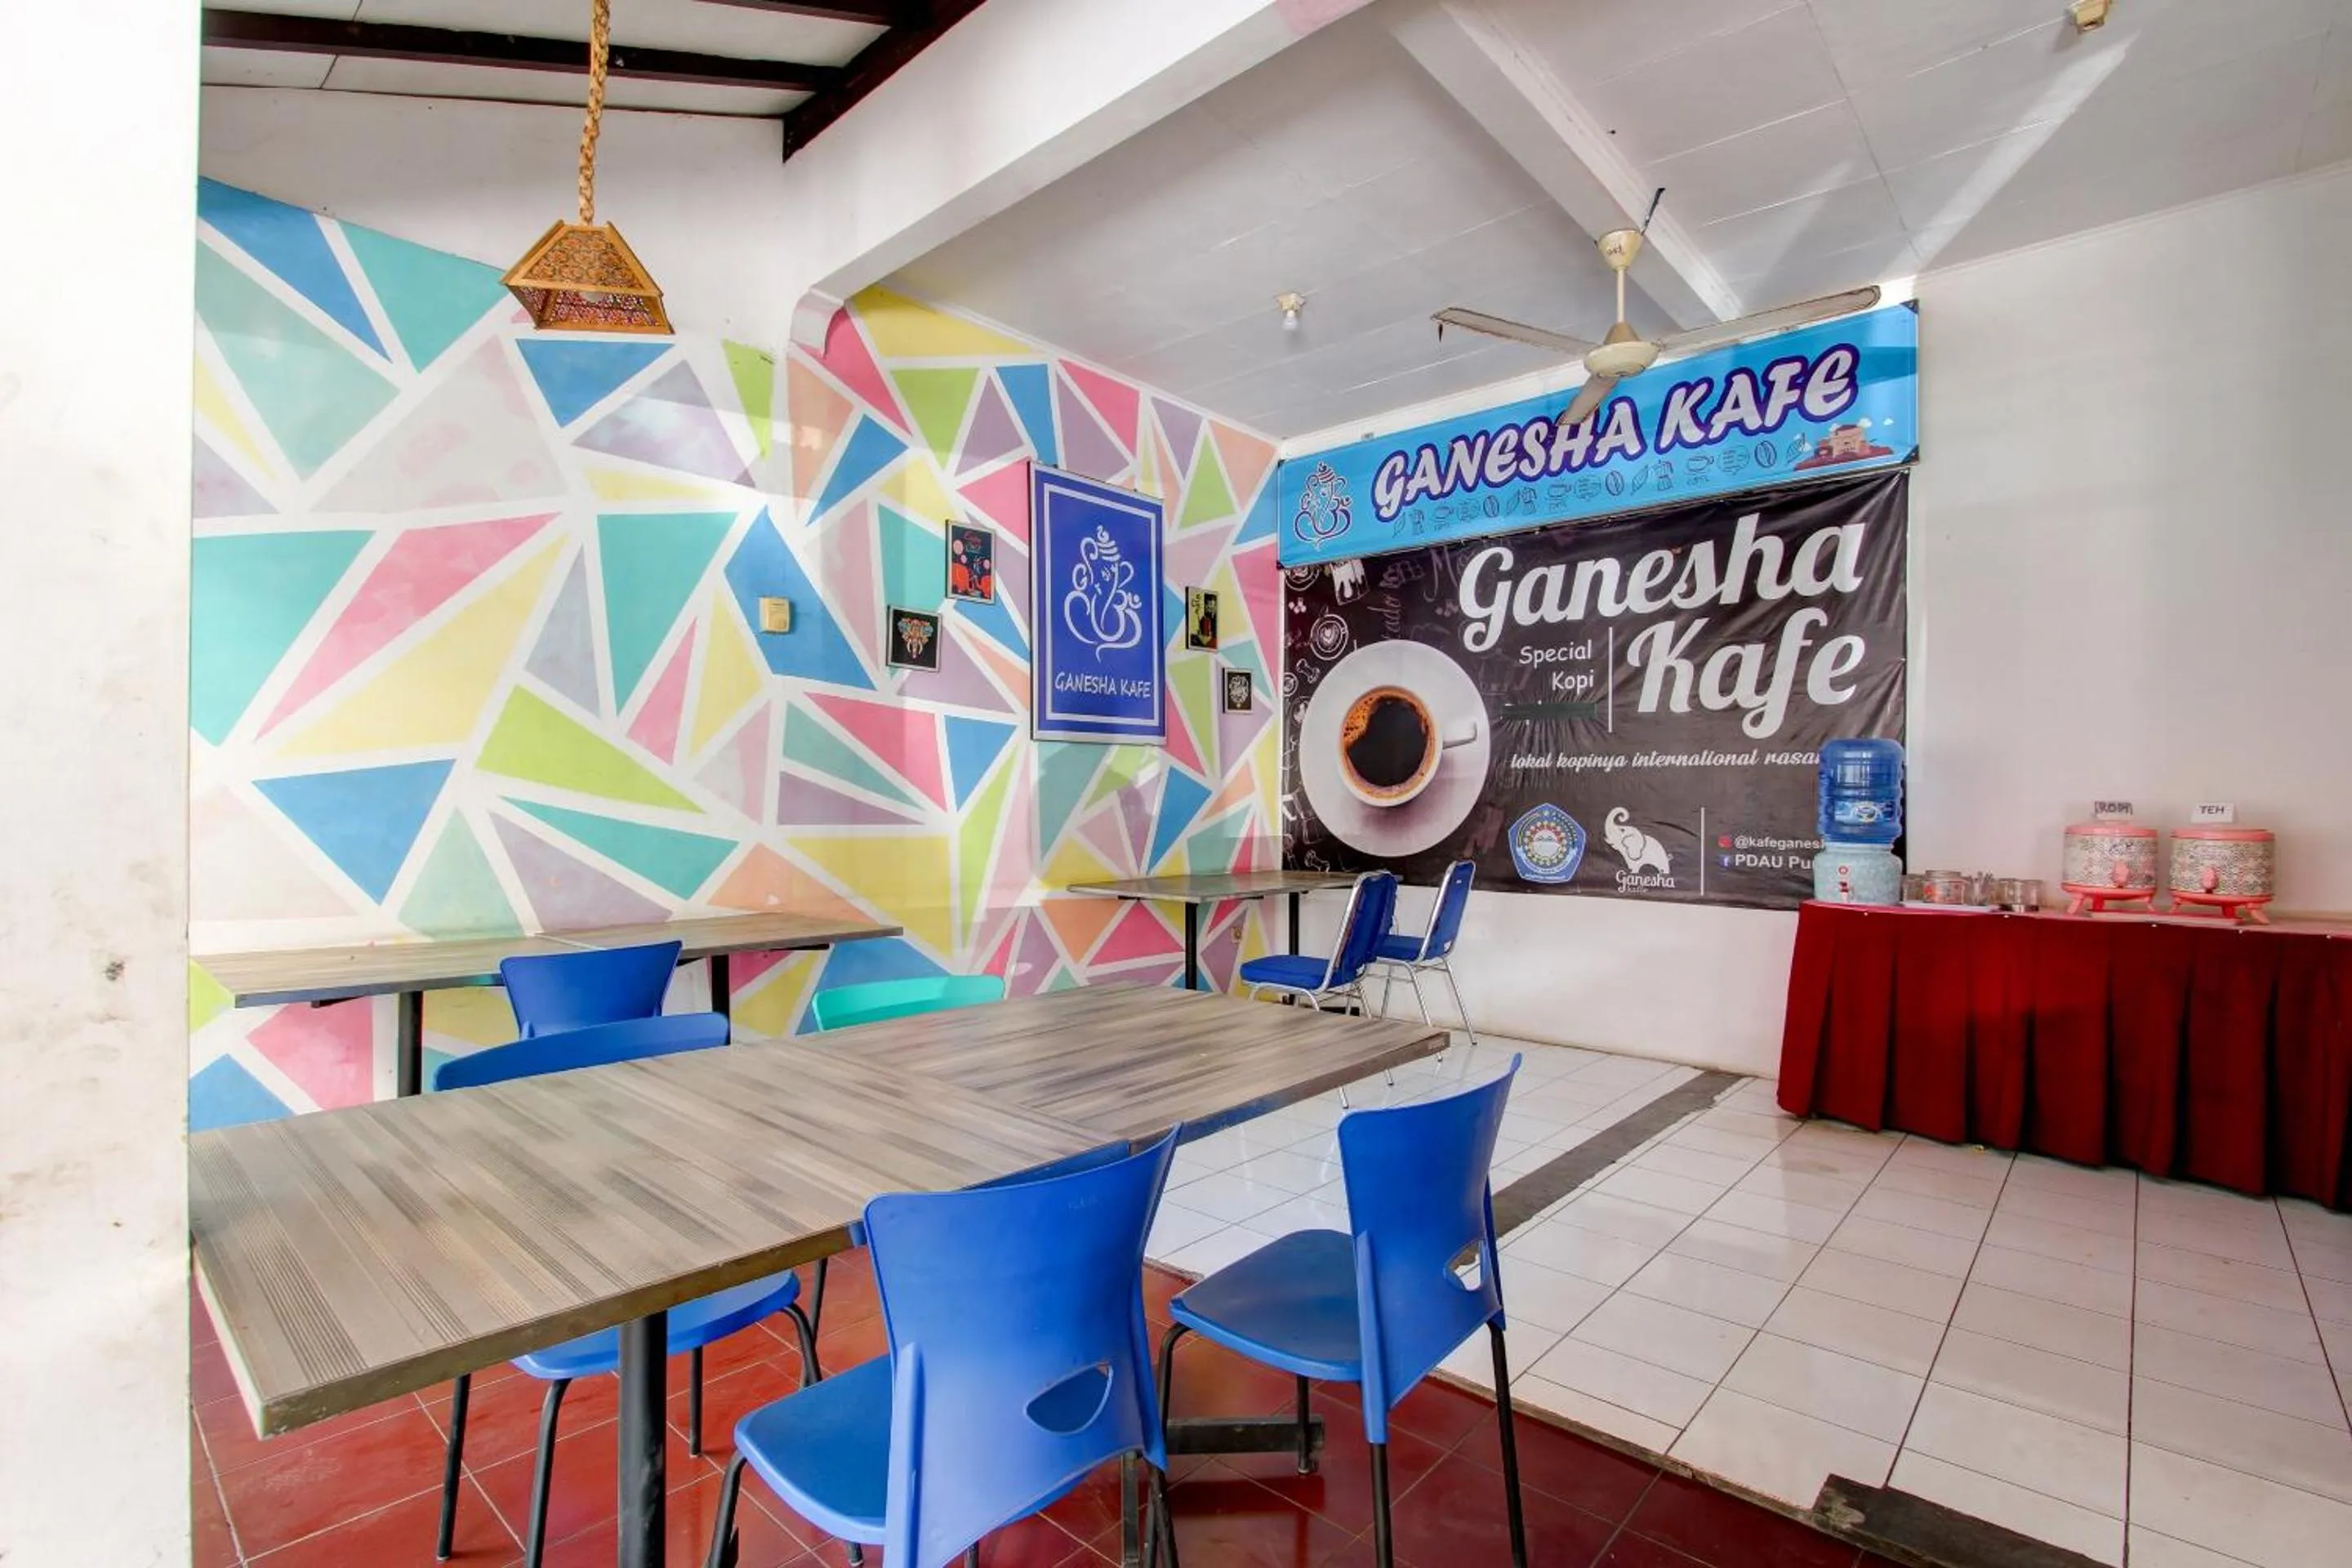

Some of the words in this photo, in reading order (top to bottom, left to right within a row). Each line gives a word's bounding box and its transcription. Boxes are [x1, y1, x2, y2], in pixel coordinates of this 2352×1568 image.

[1372, 396, 1644, 521] GANESHA
[1656, 345, 1858, 449] KAFE
[1459, 513, 1865, 653] Ganesha
[1519, 639, 1592, 669] Special
[1054, 671, 1117, 696] GANESHA
[1120, 679, 1151, 698] KAFE
[1552, 670, 1594, 694] Kopi
[1627, 607, 1865, 739] Kafe
[1511, 753, 1552, 769] lokal
[1556, 752, 1627, 773] kopinya
[1632, 748, 1759, 768] international
[2200, 804, 2225, 815] TEH
[1735, 853, 1783, 868] PDAU
[1615, 870, 1675, 893] Ganesha
